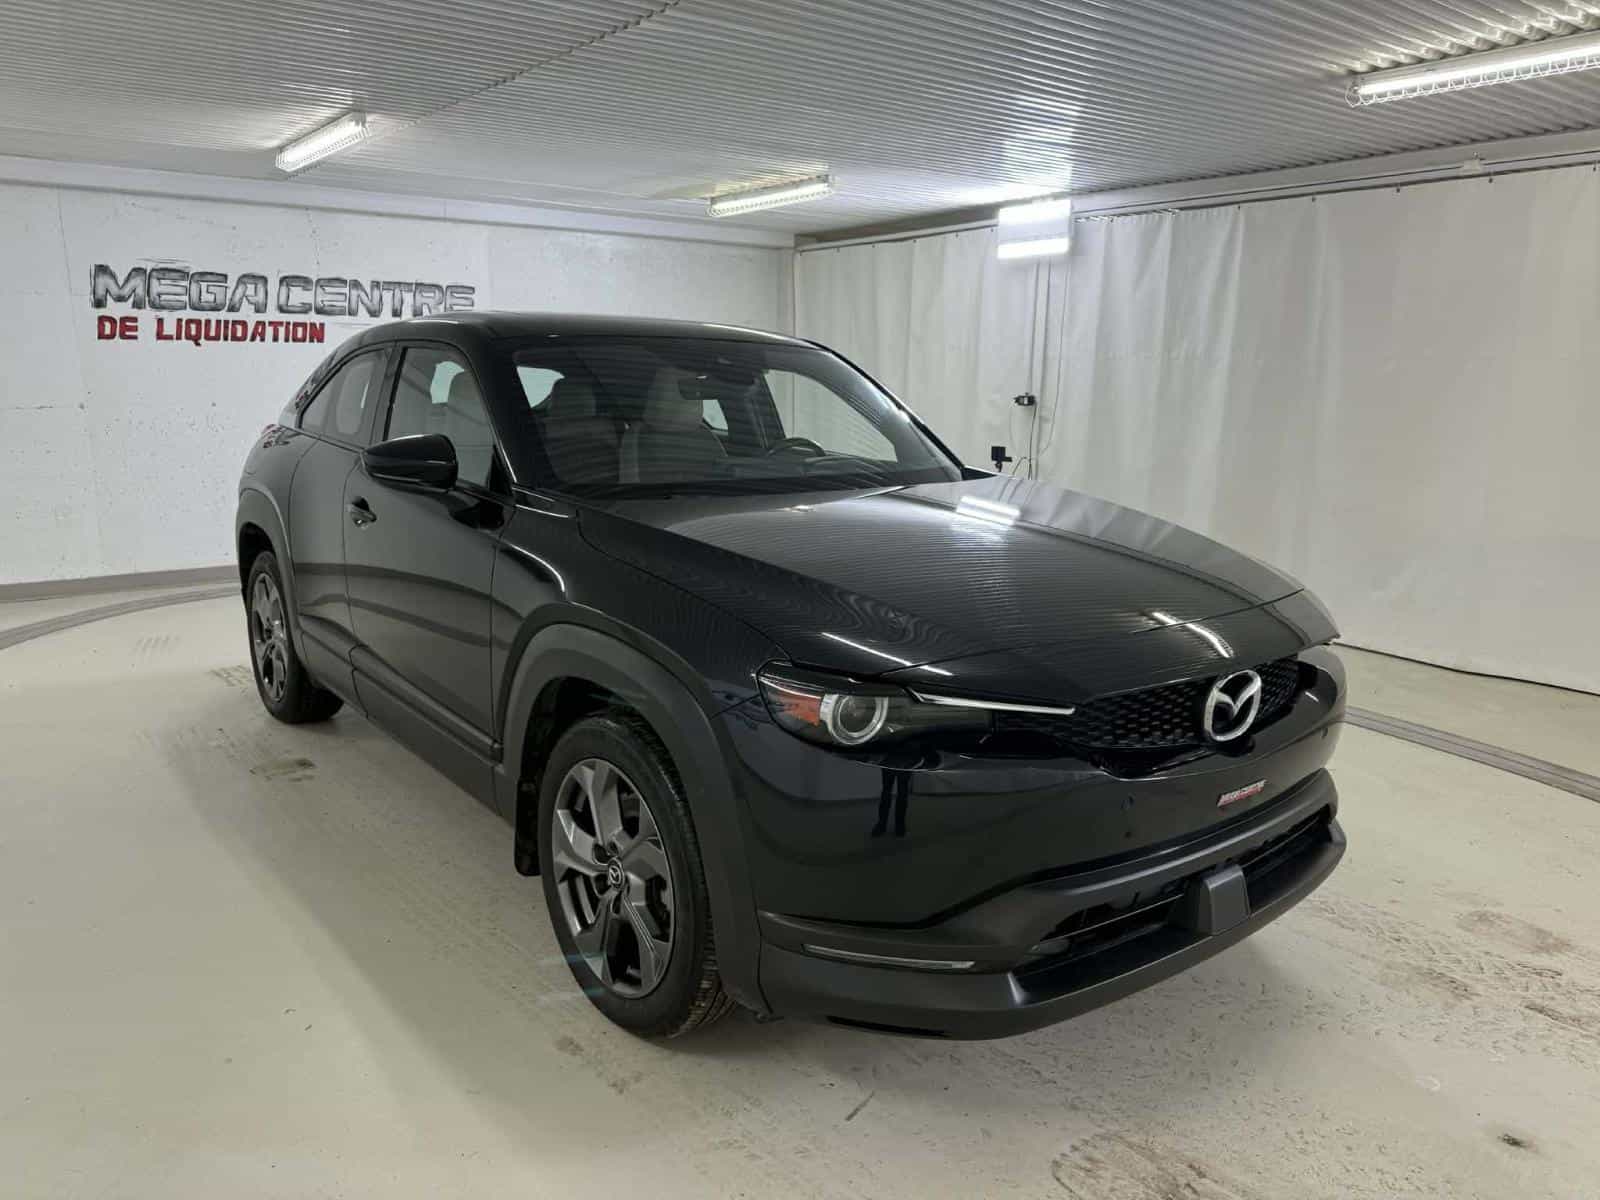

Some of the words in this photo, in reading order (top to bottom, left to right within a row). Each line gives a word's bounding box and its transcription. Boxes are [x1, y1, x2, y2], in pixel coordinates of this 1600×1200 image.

[91, 263, 269, 313] MEGA
[277, 274, 476, 318] CENTRE
[97, 315, 139, 341] DE
[155, 317, 326, 346] LIQUIDATION
